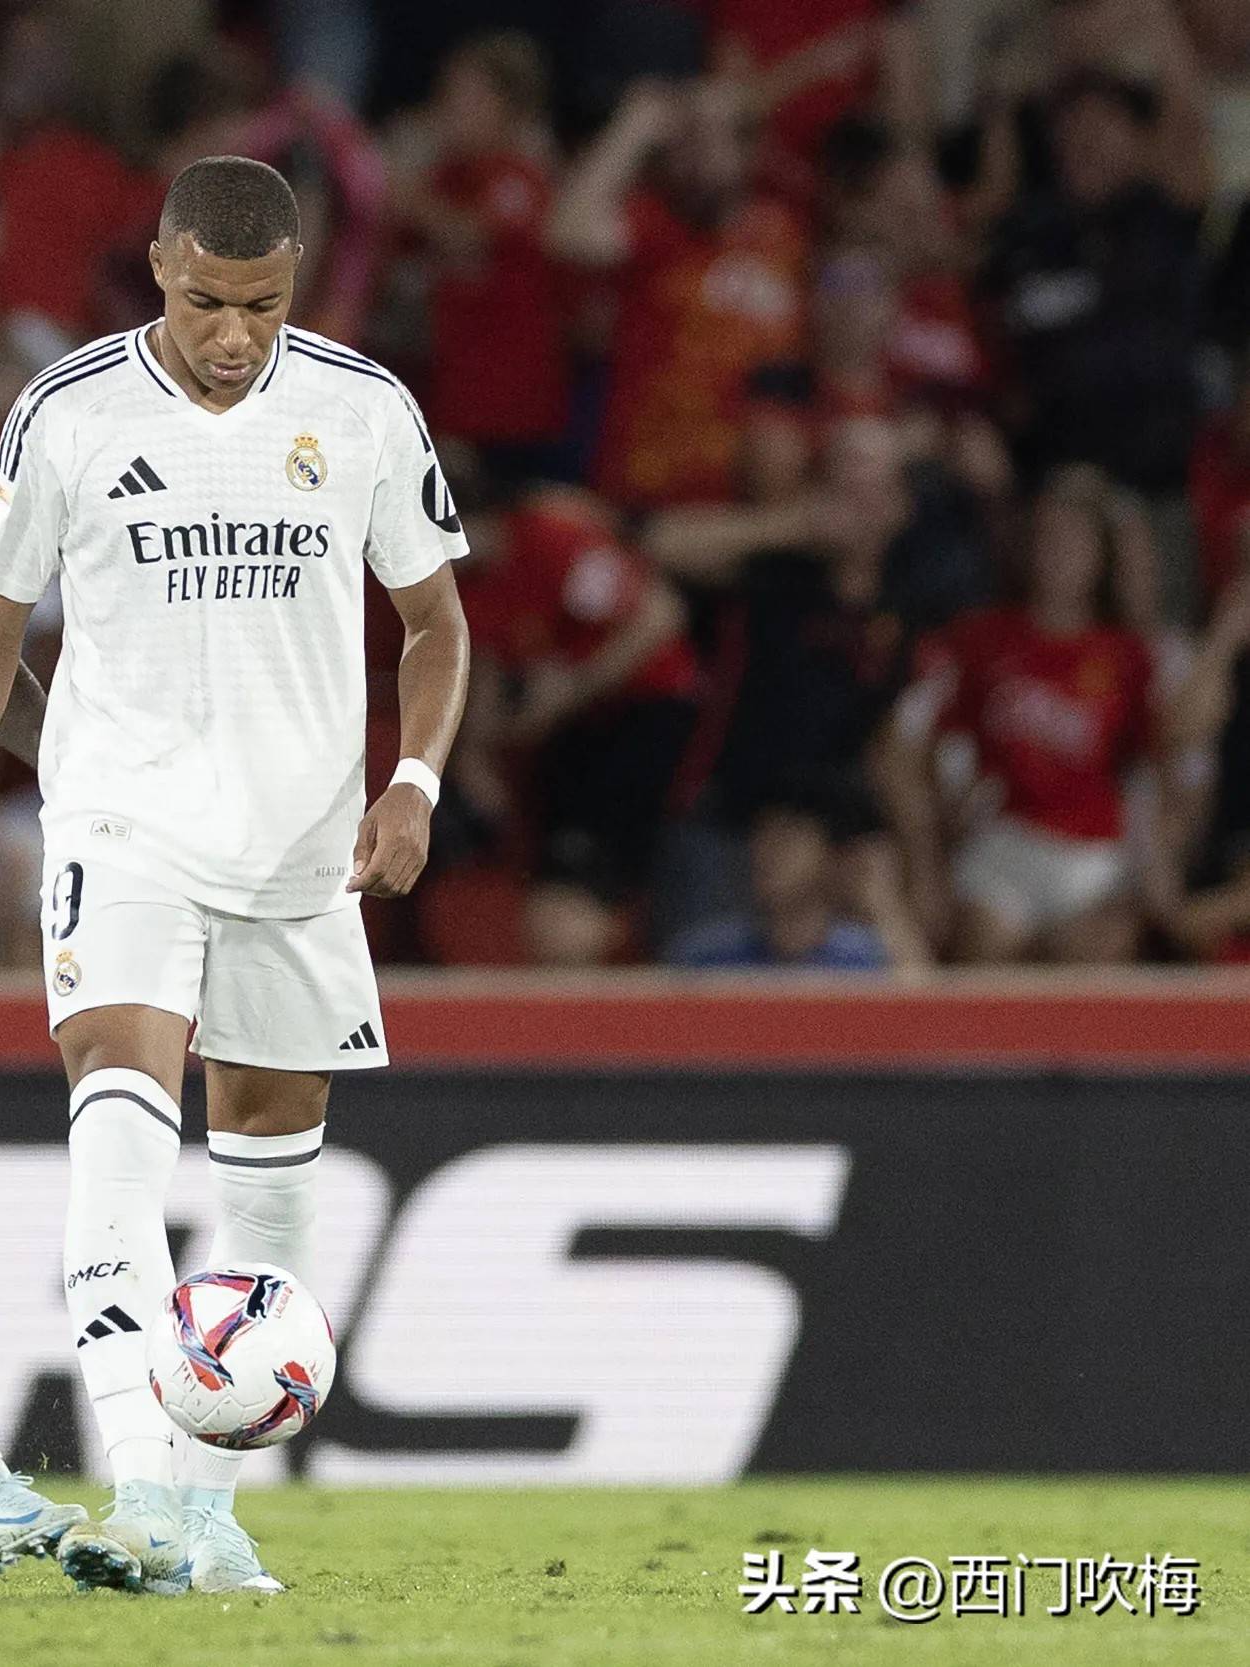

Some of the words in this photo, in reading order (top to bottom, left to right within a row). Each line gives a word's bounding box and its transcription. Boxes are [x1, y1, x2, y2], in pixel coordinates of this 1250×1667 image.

[126, 512, 329, 564] Emirates
[167, 566, 208, 603] FLY
[214, 565, 301, 600] BETTER
